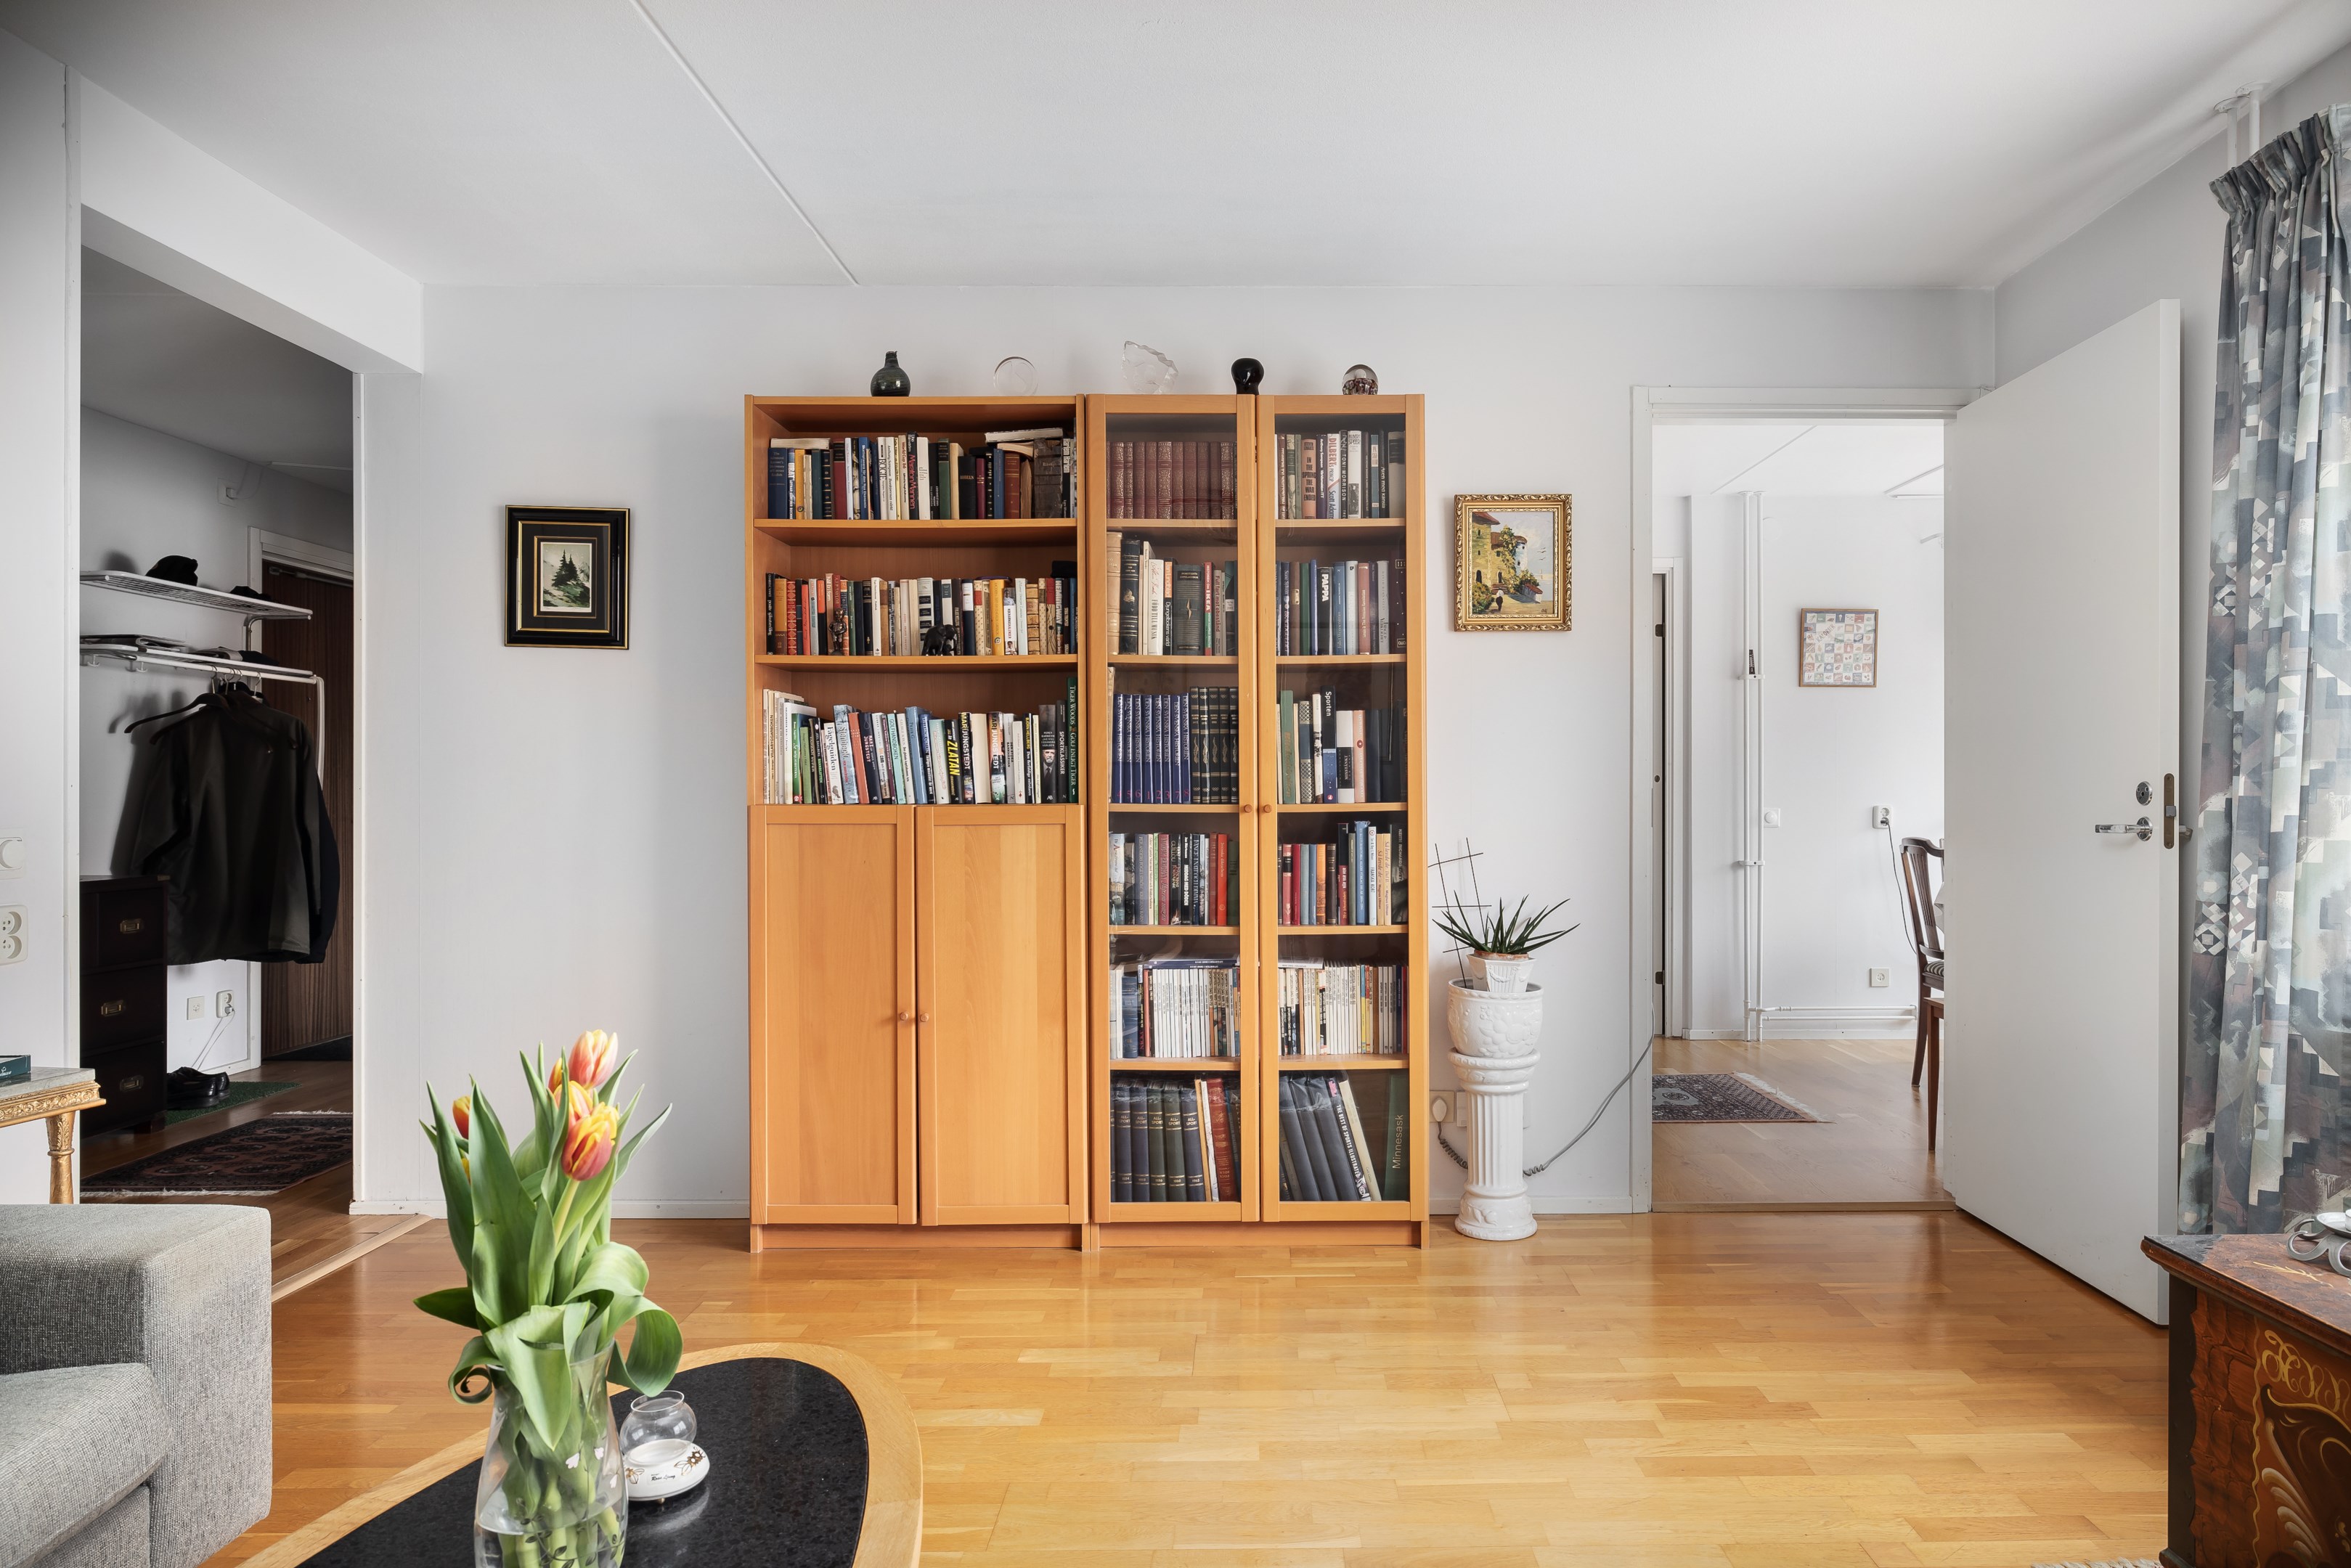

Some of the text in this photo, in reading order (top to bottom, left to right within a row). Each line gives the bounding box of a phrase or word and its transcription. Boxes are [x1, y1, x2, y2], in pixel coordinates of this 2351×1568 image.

[826, 727, 836, 771] Fågelguiden
[889, 719, 898, 760] GOLFHANDBOKEN
[947, 740, 960, 776] ZLATAN
[1117, 790, 1121, 799] 4
[1156, 791, 1162, 799] 2
[1343, 1130, 1353, 1148] SPORTS
[1392, 1114, 1403, 1169] Minnesask
[1347, 1147, 1361, 1179] ILLUSTRATED
